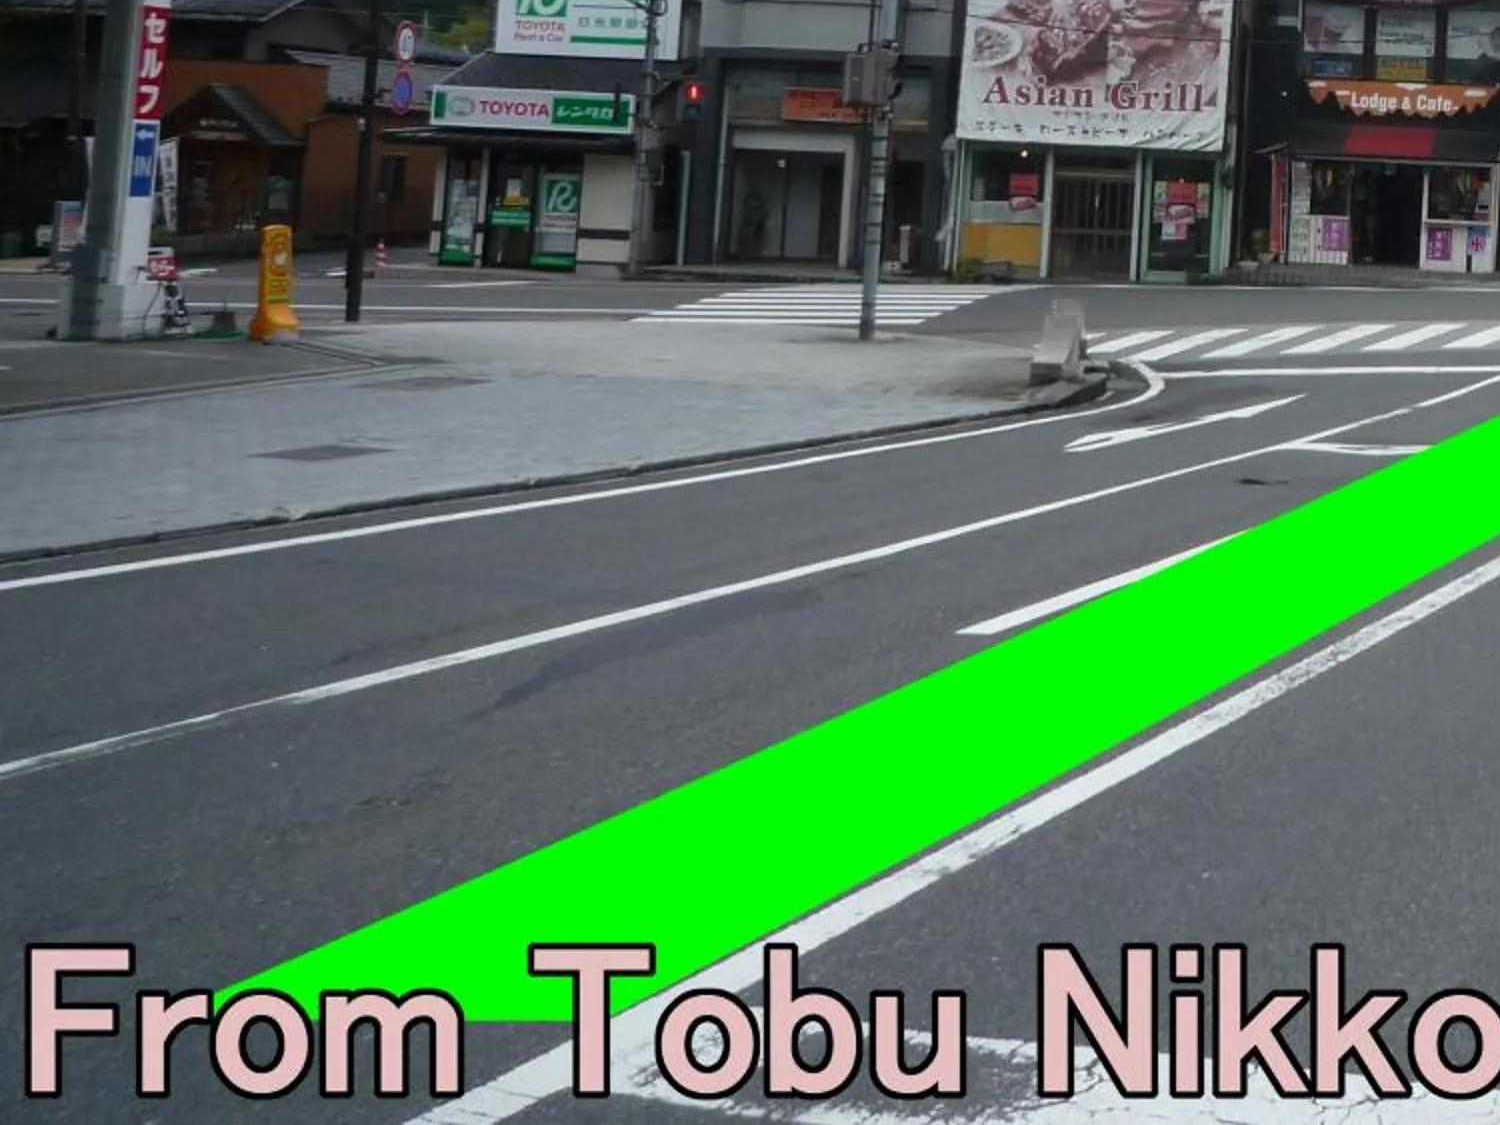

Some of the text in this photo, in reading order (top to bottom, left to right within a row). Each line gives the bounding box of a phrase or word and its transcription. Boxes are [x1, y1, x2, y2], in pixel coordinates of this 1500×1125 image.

[516, 20, 565, 32] TOYOTA
[139, 12, 167, 114] セルフ
[983, 76, 1211, 112] Asian Grill
[1351, 91, 1397, 111] Lodge
[1401, 97, 1412, 109] &
[479, 101, 619, 120] TOYOTA レンタカ
[975, 121, 1023, 133] ステーキ
[133, 154, 153, 178] IN
